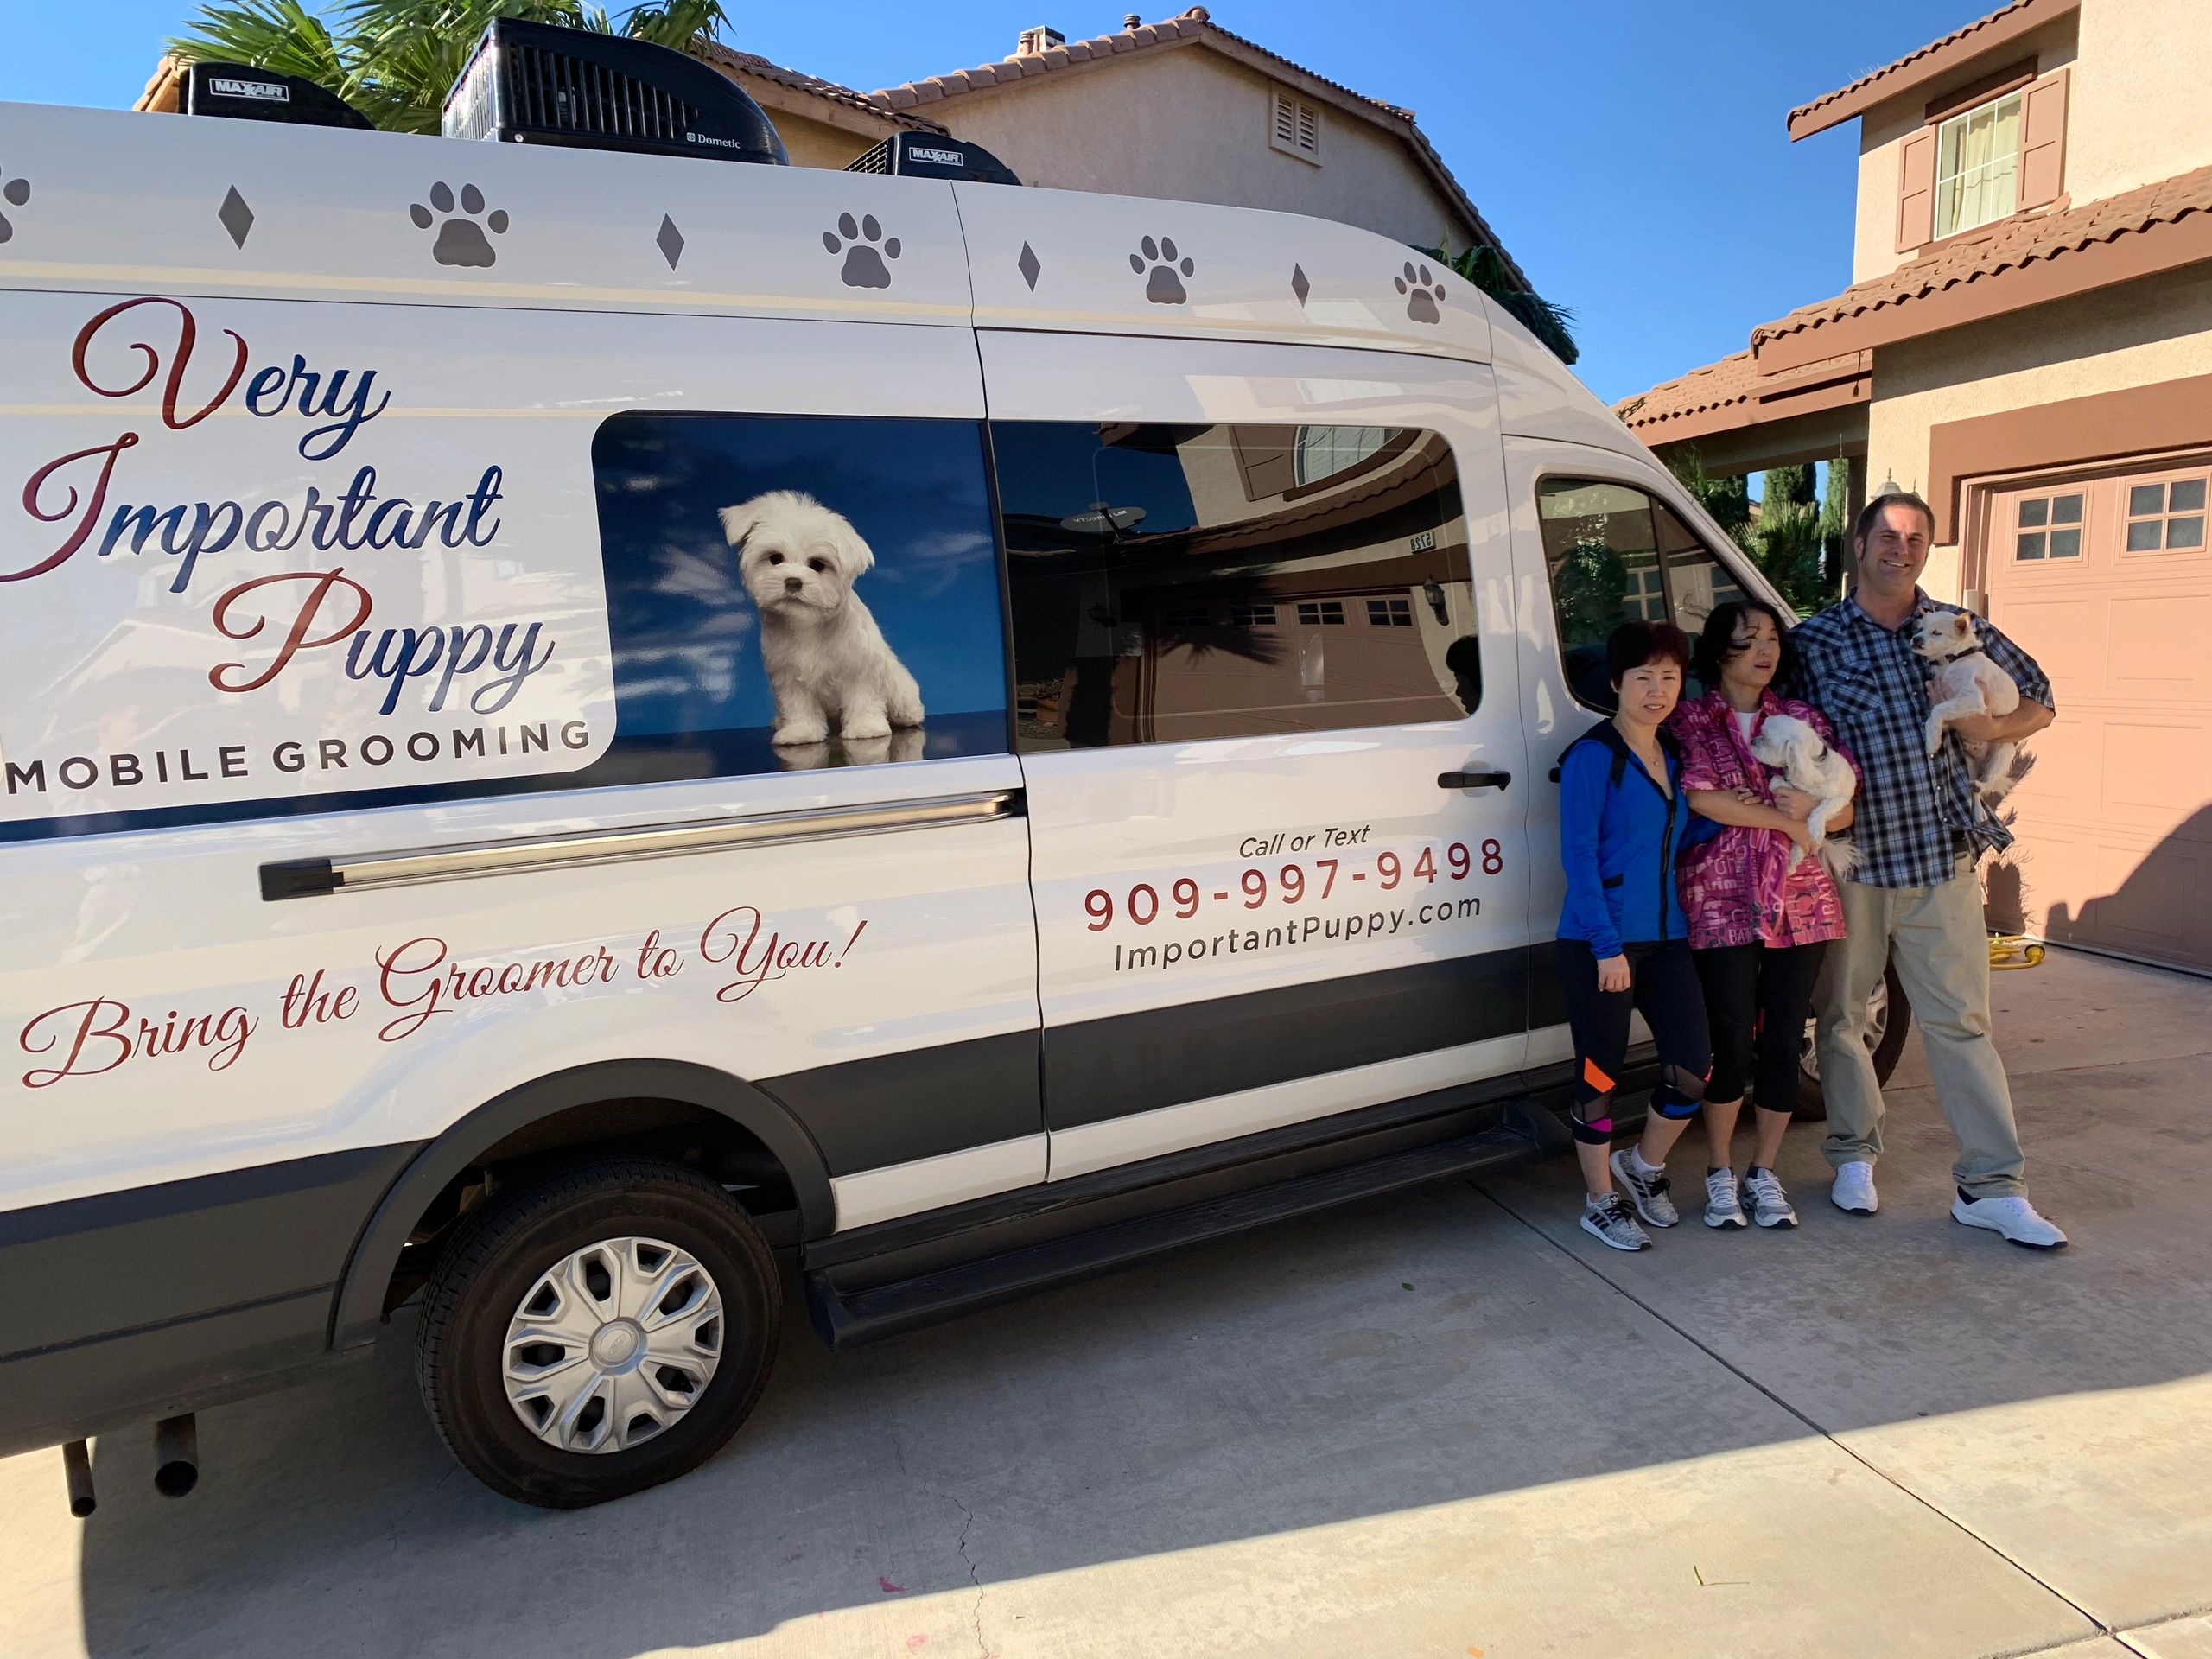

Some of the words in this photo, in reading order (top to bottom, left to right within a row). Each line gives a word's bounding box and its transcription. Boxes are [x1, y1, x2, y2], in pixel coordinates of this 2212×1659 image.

[698, 133, 741, 149] Dometic
[72, 296, 391, 461] Very
[0, 432, 505, 594] Important
[208, 567, 556, 715] Puppy
[6, 745, 250, 795] MOBILE
[272, 721, 591, 773] GROOMING
[1084, 838, 1504, 932] 909-997-9498
[1238, 834, 1284, 859] Call
[1291, 832, 1317, 852] or
[1324, 823, 1371, 849] Text
[1115, 895, 1483, 972] ImportantPuppy.com
[19, 995, 258, 1089] Bring
[280, 968, 359, 1030] the
[375, 937, 620, 1043] Groomer
[637, 929, 685, 980] to
[699, 906, 868, 1003] You!
